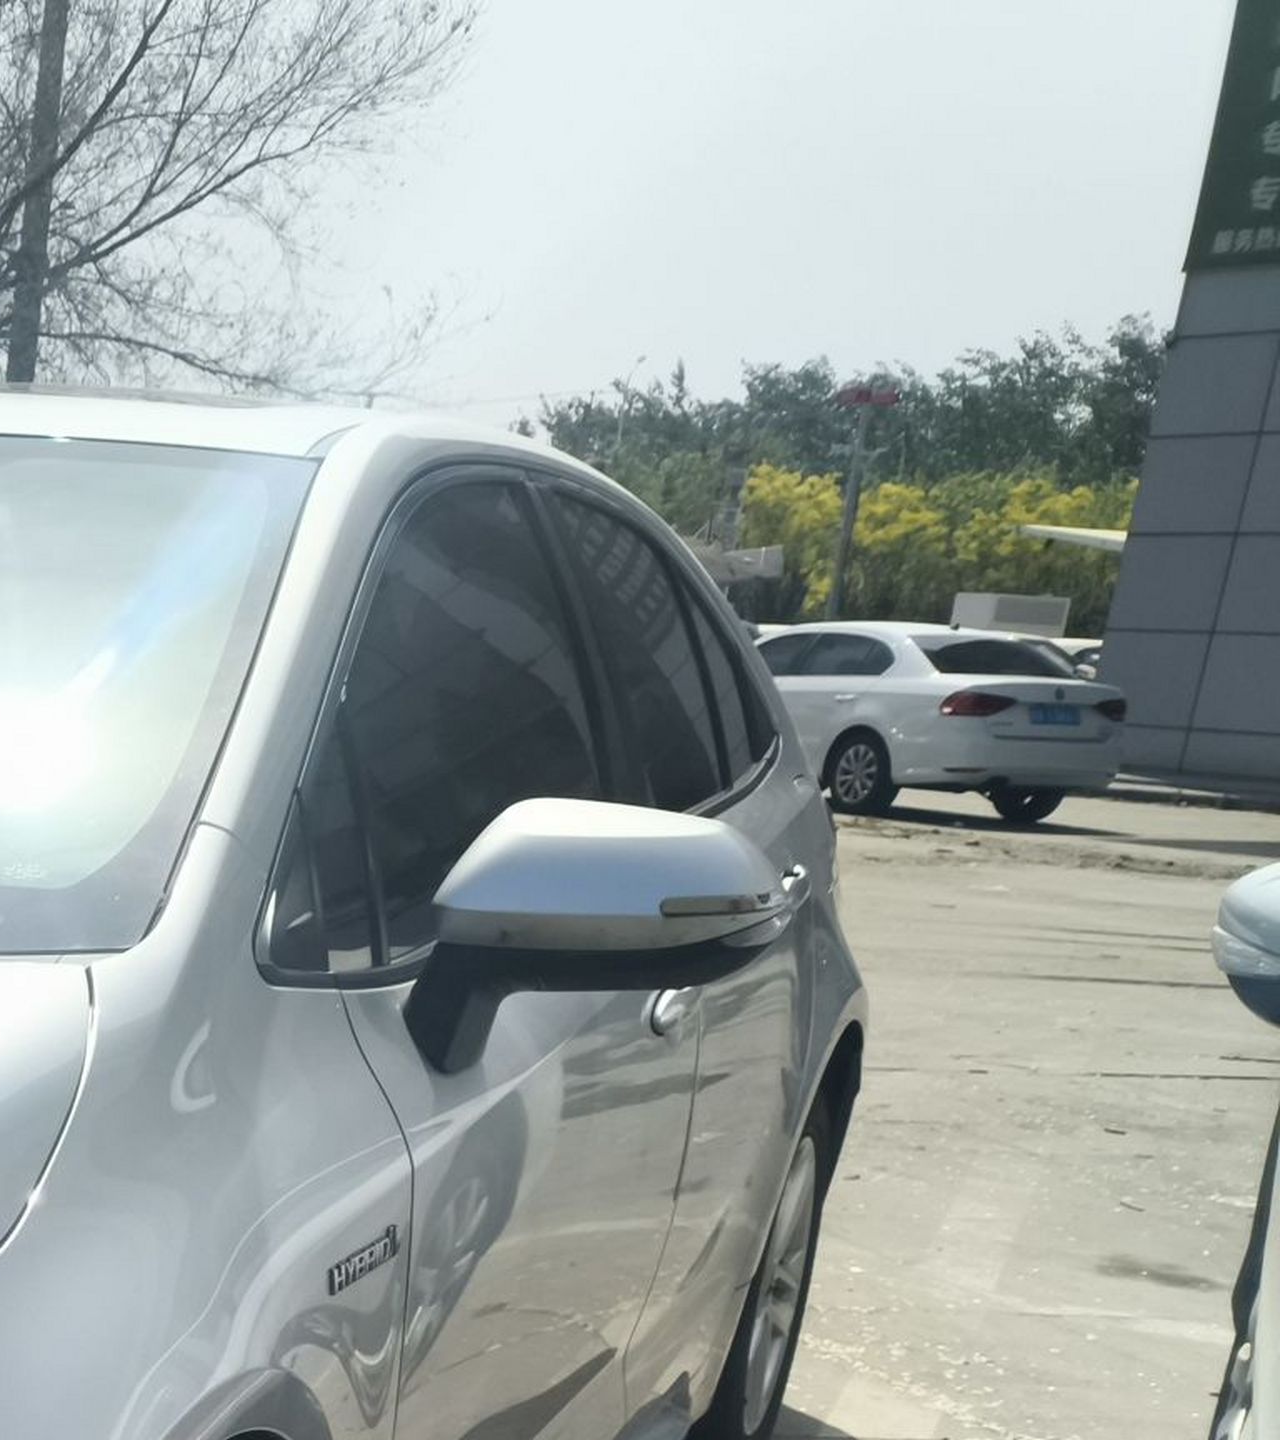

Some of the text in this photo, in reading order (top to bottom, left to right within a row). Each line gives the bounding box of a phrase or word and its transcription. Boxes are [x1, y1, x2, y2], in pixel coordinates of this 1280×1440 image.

[1211, 226, 1280, 254] 服务热
[330, 1231, 394, 1293] HYBRID
